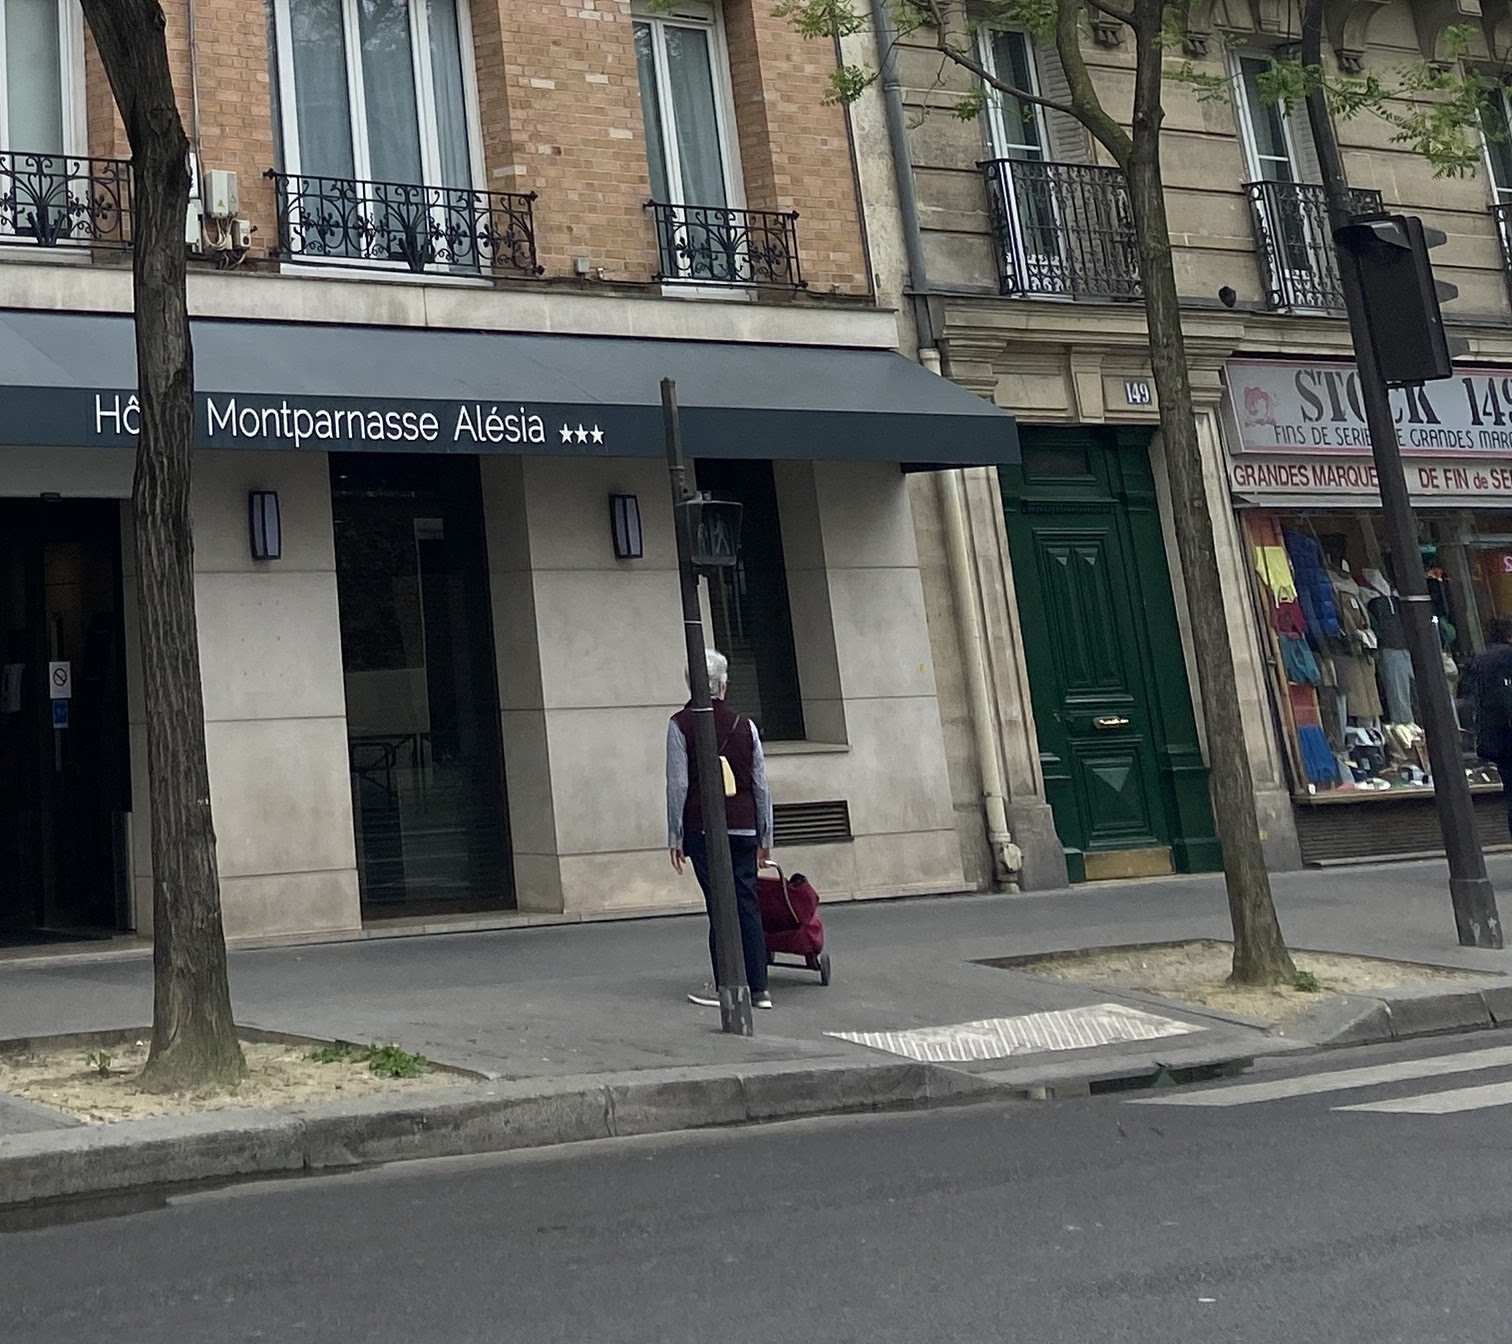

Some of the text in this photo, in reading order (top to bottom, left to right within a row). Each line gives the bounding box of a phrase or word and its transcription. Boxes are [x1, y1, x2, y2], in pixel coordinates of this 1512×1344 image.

[1125, 382, 1151, 404] 149
[1294, 368, 1441, 425] STOK
[206, 397, 439, 448] Montparnasse
[453, 404, 546, 443] Alésia
[1311, 426, 1332, 446] DE
[1335, 427, 1372, 447] SERIE
[1409, 428, 1474, 449] GRANDES
[1478, 430, 1512, 449] MAR
[1233, 464, 1310, 487] GRANDES
[1312, 465, 1379, 488] MARQUE
[1418, 467, 1440, 489] DE
[1443, 468, 1470, 490] FIN
[1473, 471, 1489, 490] de
